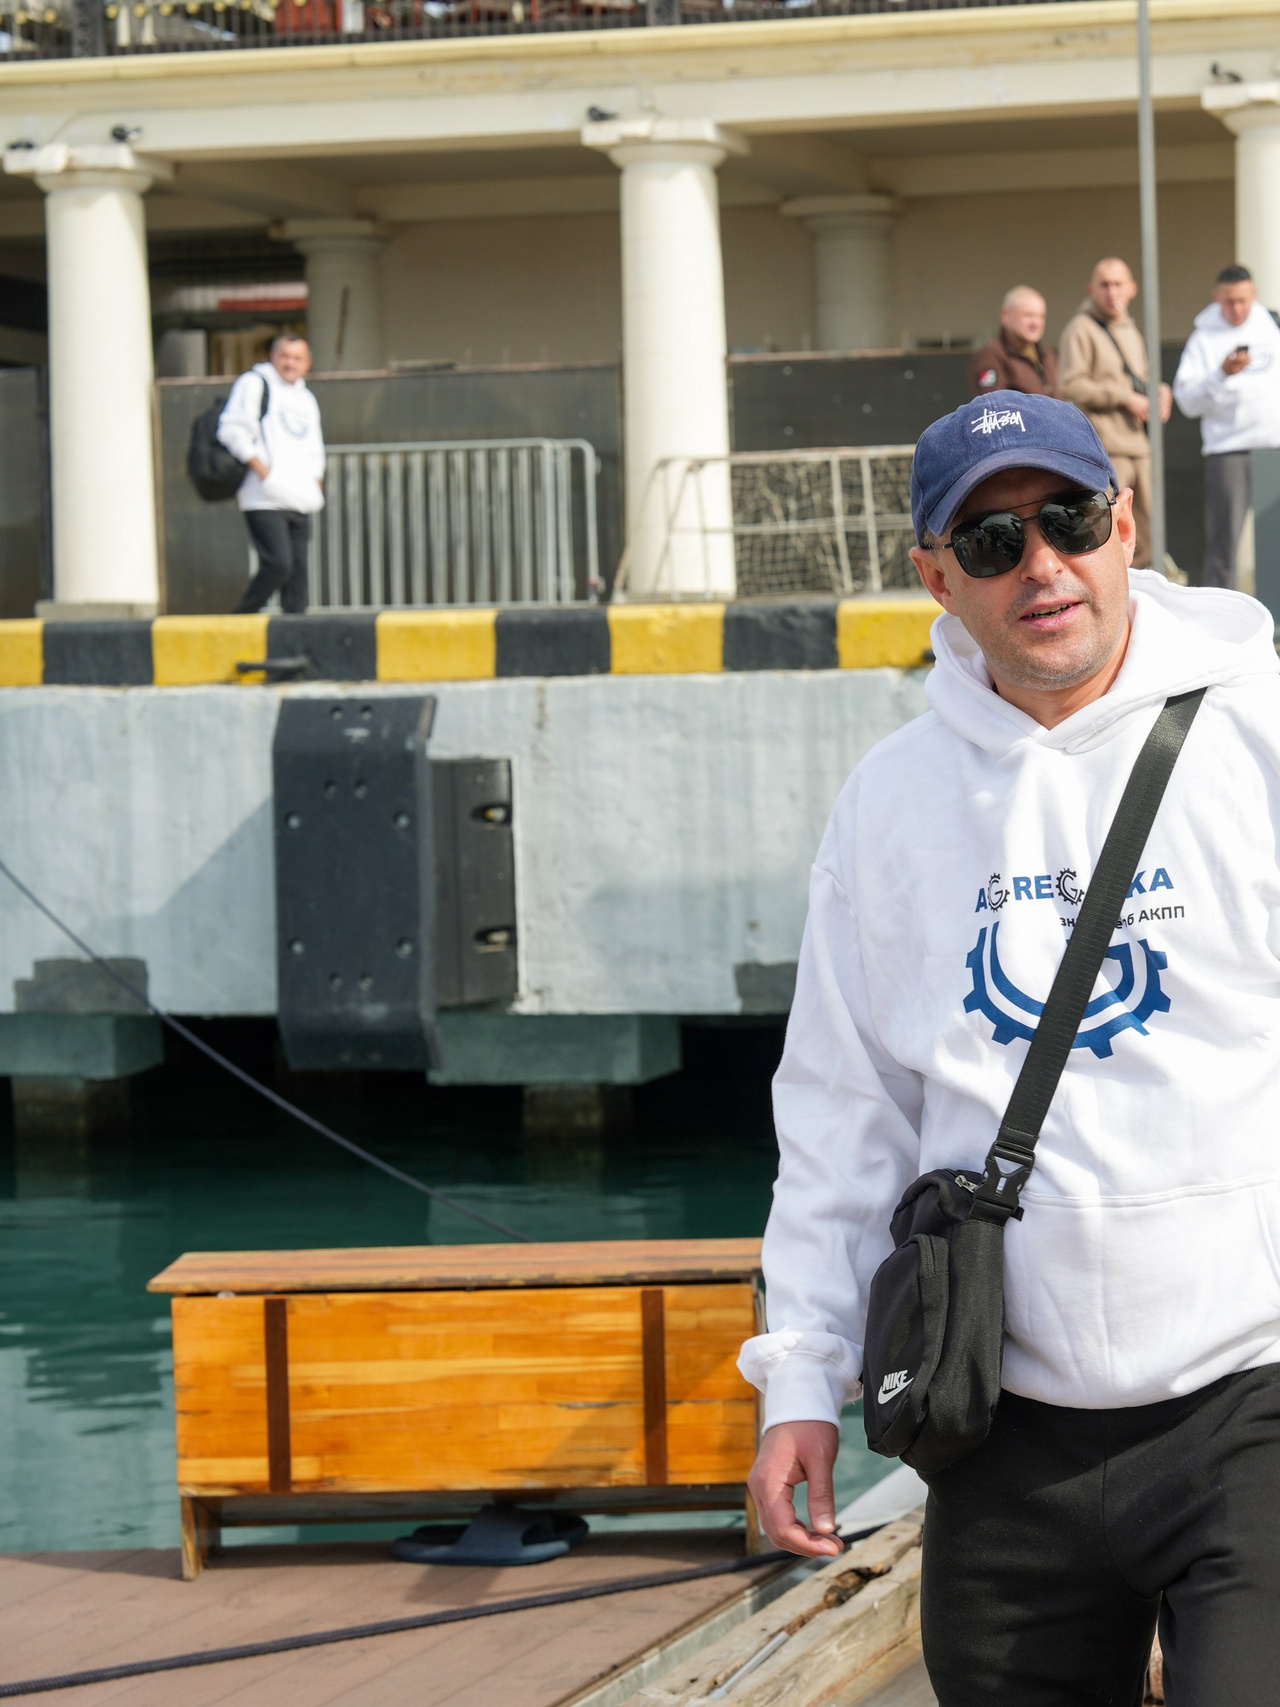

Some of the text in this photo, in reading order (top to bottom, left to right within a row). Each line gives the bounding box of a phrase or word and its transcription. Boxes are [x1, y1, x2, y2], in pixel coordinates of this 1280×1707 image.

[975, 867, 1174, 912] AGREGKA
[1138, 905, 1185, 923] АКПП
[882, 1369, 908, 1391] NIKE
